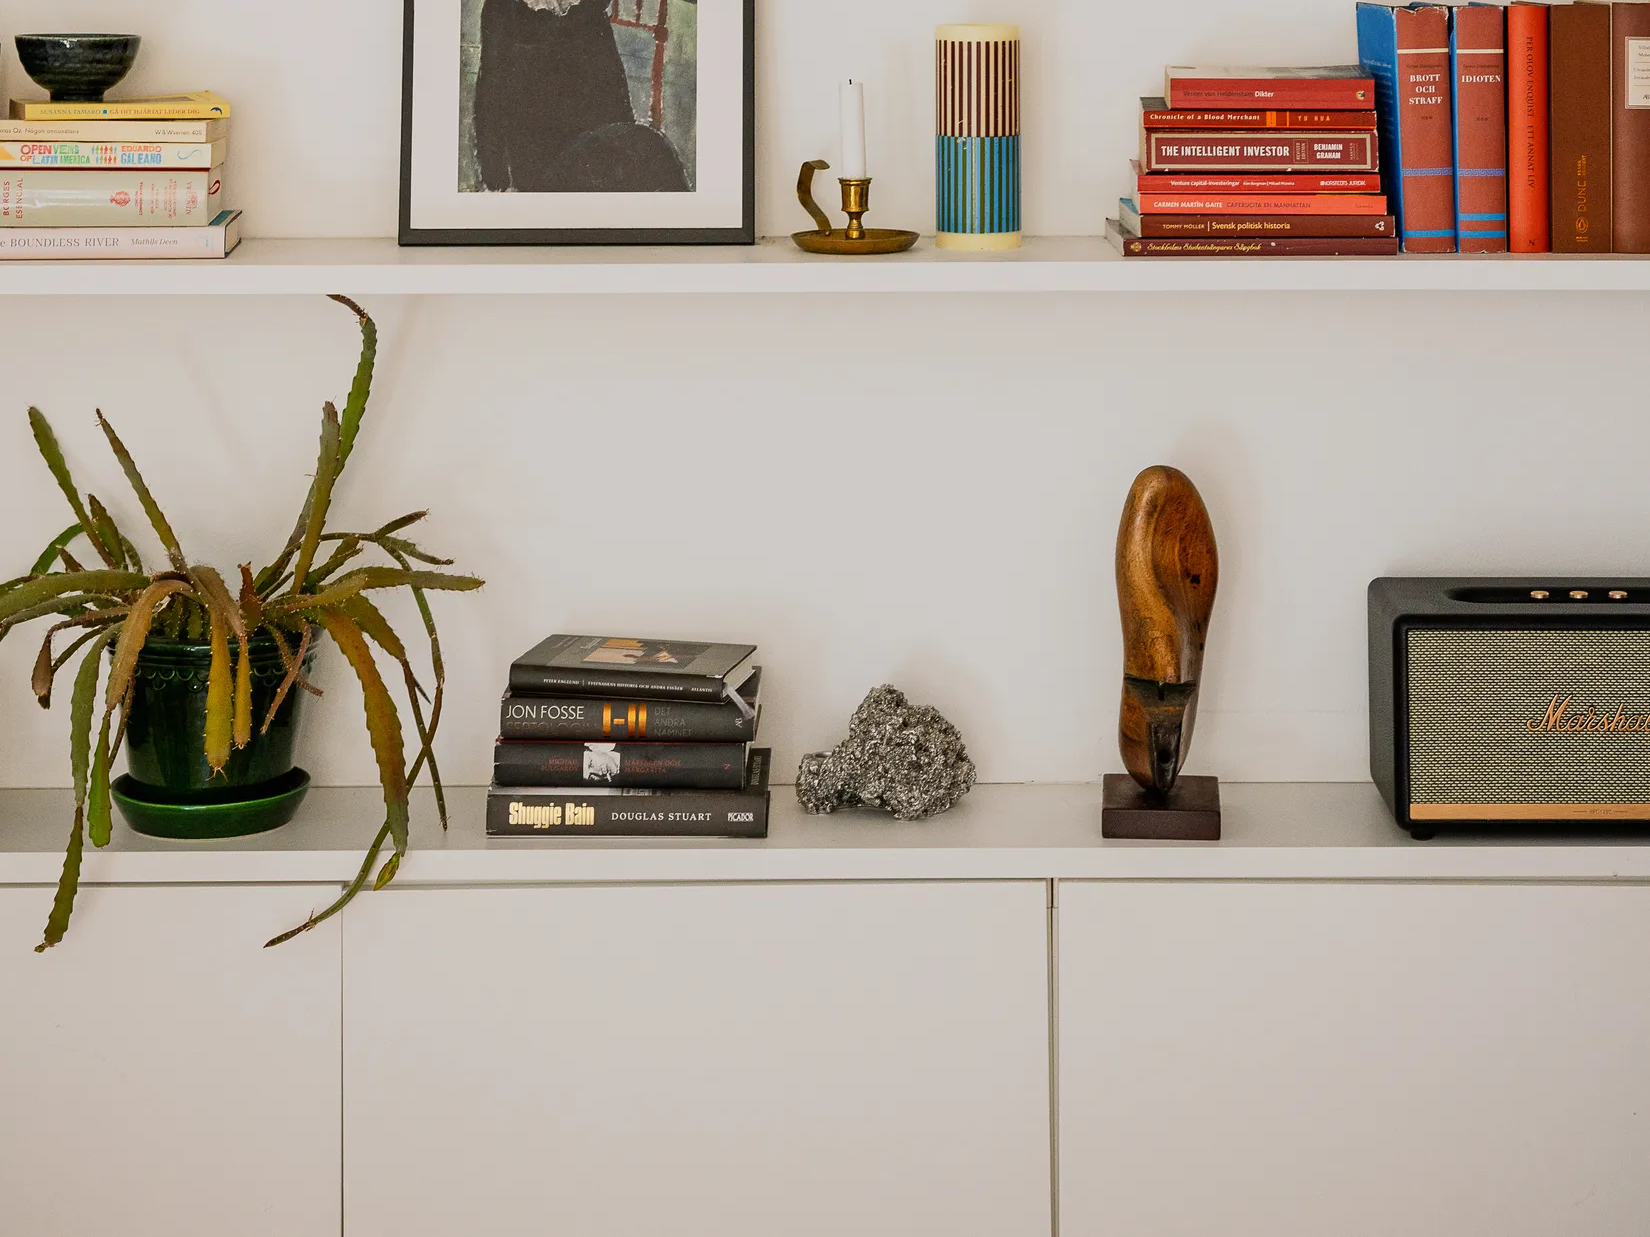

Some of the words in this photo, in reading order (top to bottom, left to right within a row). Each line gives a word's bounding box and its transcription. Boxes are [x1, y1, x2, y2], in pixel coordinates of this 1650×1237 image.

[1410, 74, 1440, 82] BROTT
[1461, 74, 1500, 83] IDIOTEN
[1416, 85, 1435, 93] OCH
[1409, 96, 1443, 105] STRAFF
[20, 145, 51, 155] OPEN
[1161, 146, 1179, 157] THE
[1181, 146, 1240, 157] INTELLIGENT
[1244, 146, 1289, 157] INVESTOR
[1314, 143, 1342, 151] BENJAMIN
[1316, 151, 1341, 159] GRAHAM
[1212, 221, 1235, 230] Svensk
[1237, 221, 1262, 231] politisk
[1264, 221, 1290, 230] historia
[10, 238, 80, 247] BOUNDLESS
[85, 238, 119, 247] RIVER
[506, 705, 538, 719] JON
[541, 706, 584, 720] FOSSE
[654, 706, 670, 716] DET
[654, 717, 686, 727] ANDRA
[508, 802, 562, 829] Shuggie
[565, 803, 594, 825] Bain
[612, 813, 664, 821] DOUGLAS
[668, 813, 712, 821] STUART
[728, 813, 754, 822] PICADOR
